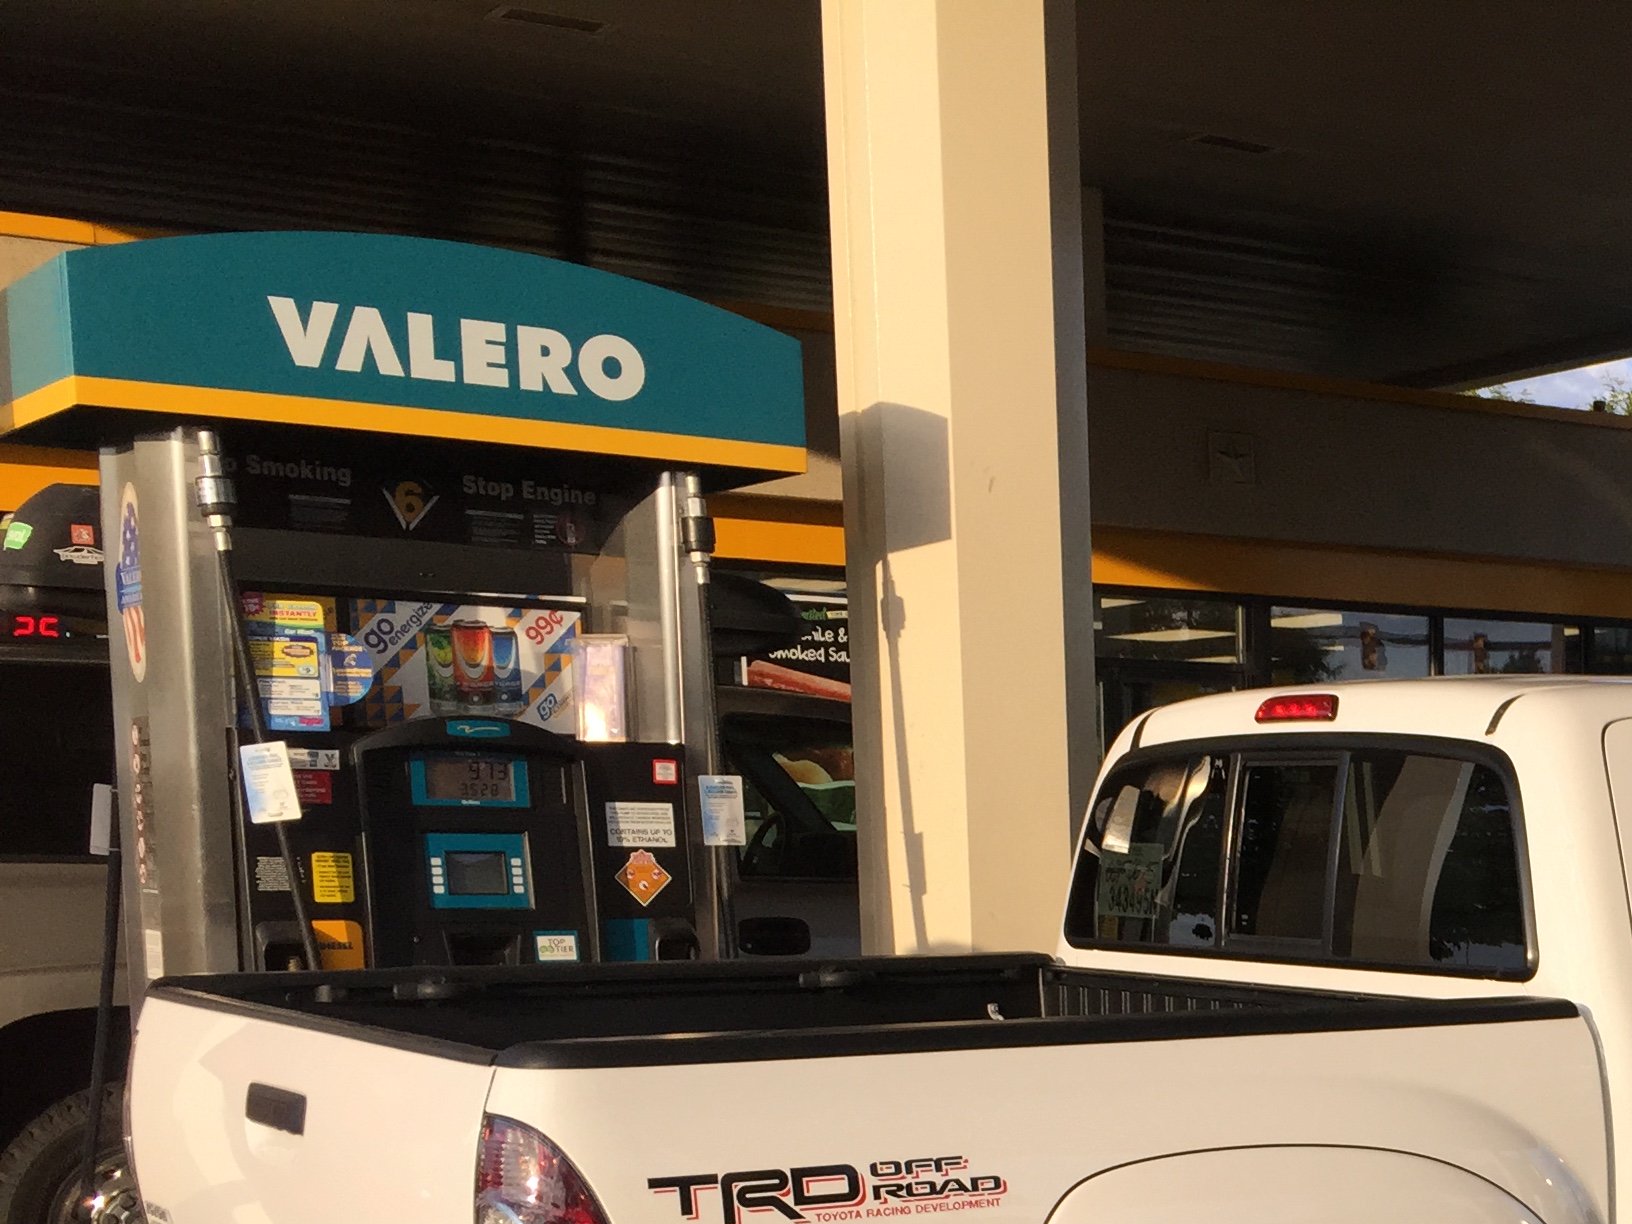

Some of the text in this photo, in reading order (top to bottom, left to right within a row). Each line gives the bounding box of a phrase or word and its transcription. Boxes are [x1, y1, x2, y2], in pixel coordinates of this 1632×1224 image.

[267, 295, 646, 401] VALERO
[246, 455, 352, 486] Smoking
[395, 481, 424, 522] 6
[463, 475, 596, 506] Stop Engine
[363, 618, 395, 654] go
[388, 603, 433, 646] energize
[525, 608, 564, 645] 99¢
[538, 696, 556, 721] go
[547, 938, 566, 946] TOP
[869, 1155, 969, 1179] OFF
[872, 1175, 1007, 1205] ROAD
[815, 1197, 1001, 1223] TOYOTA RACING DEVELOPMENT
